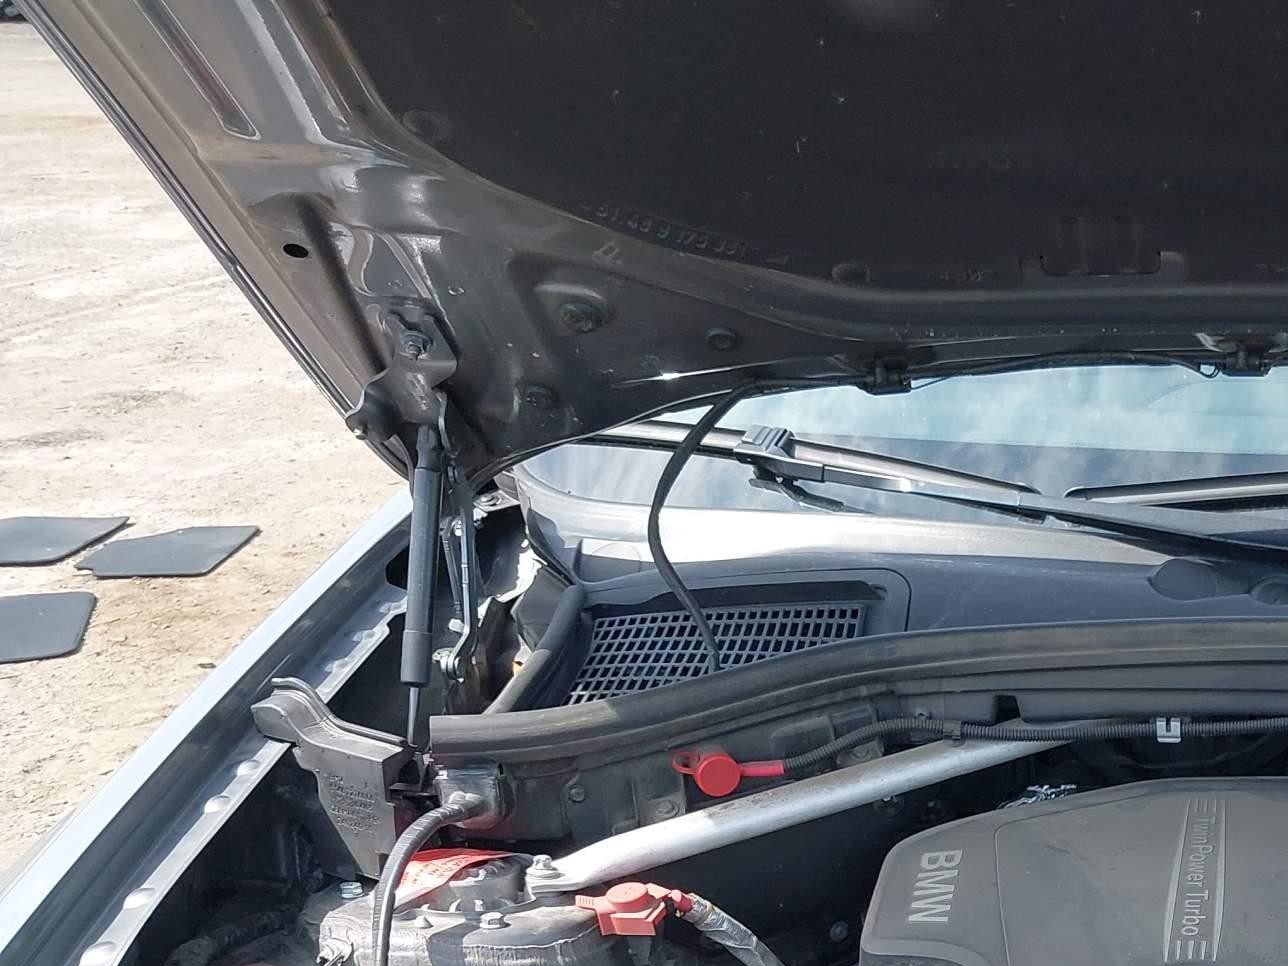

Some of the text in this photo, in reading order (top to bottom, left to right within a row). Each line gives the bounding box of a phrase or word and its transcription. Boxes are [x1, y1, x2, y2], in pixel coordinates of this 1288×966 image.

[908, 849, 963, 922] BMW
[1181, 815, 1216, 937] TwinPower Turbo
